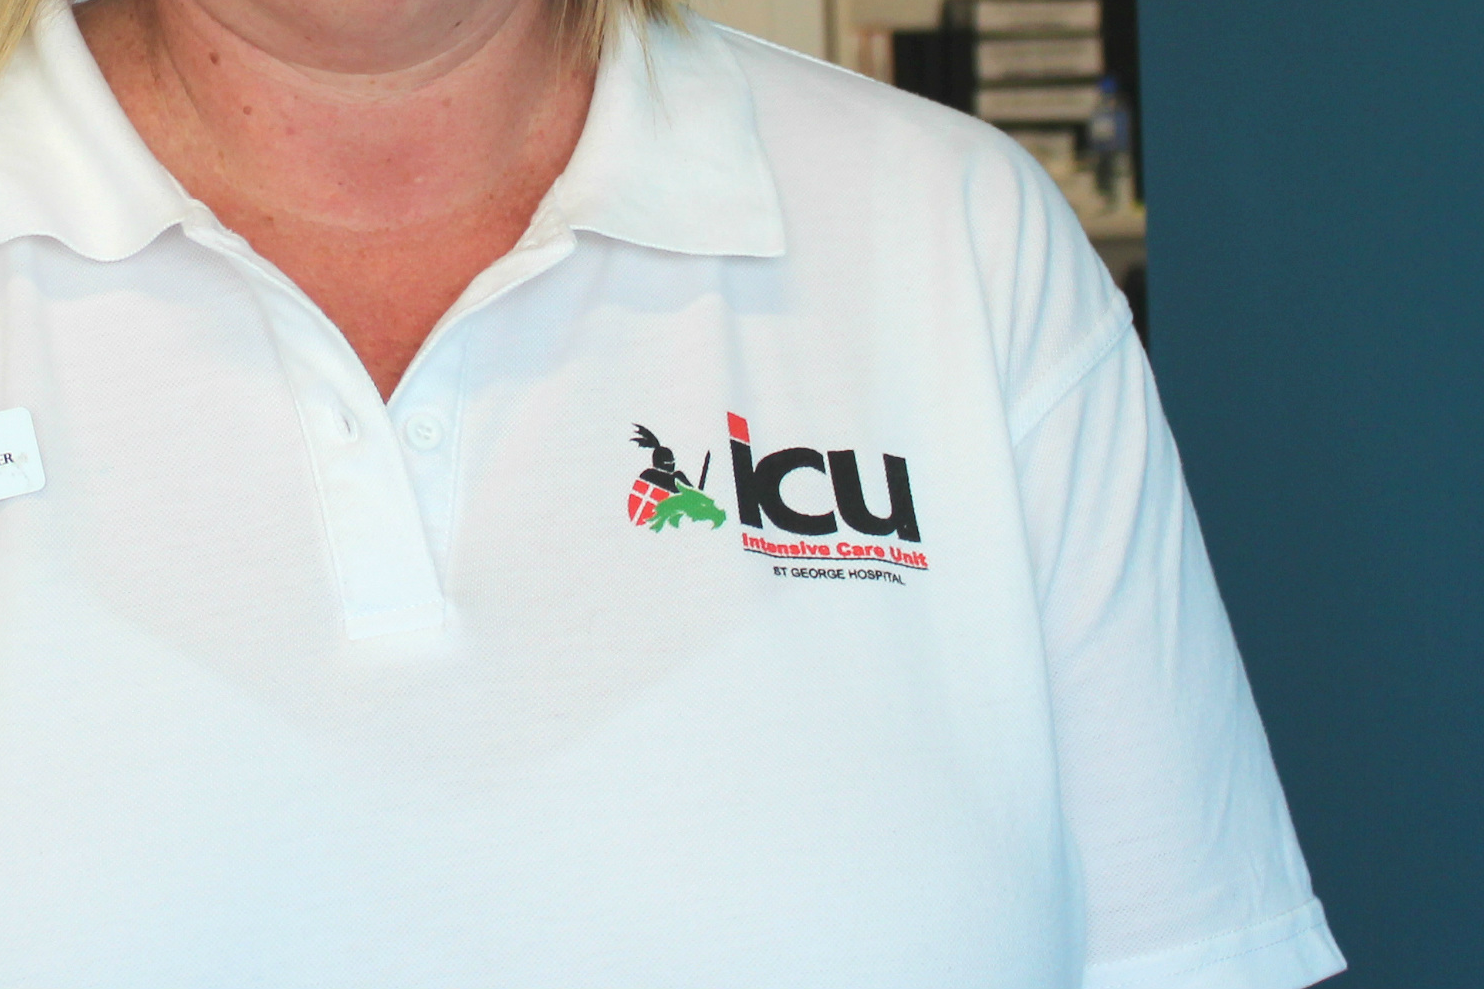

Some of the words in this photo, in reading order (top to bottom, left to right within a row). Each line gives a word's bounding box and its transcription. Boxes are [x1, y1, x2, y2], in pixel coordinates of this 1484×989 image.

[742, 533, 830, 557] Intensive
[837, 542, 885, 558] Care
[890, 547, 928, 568] Unit
[774, 566, 787, 576] ST
[791, 567, 845, 580] GEORGE
[849, 570, 905, 585] HOSPITAL
